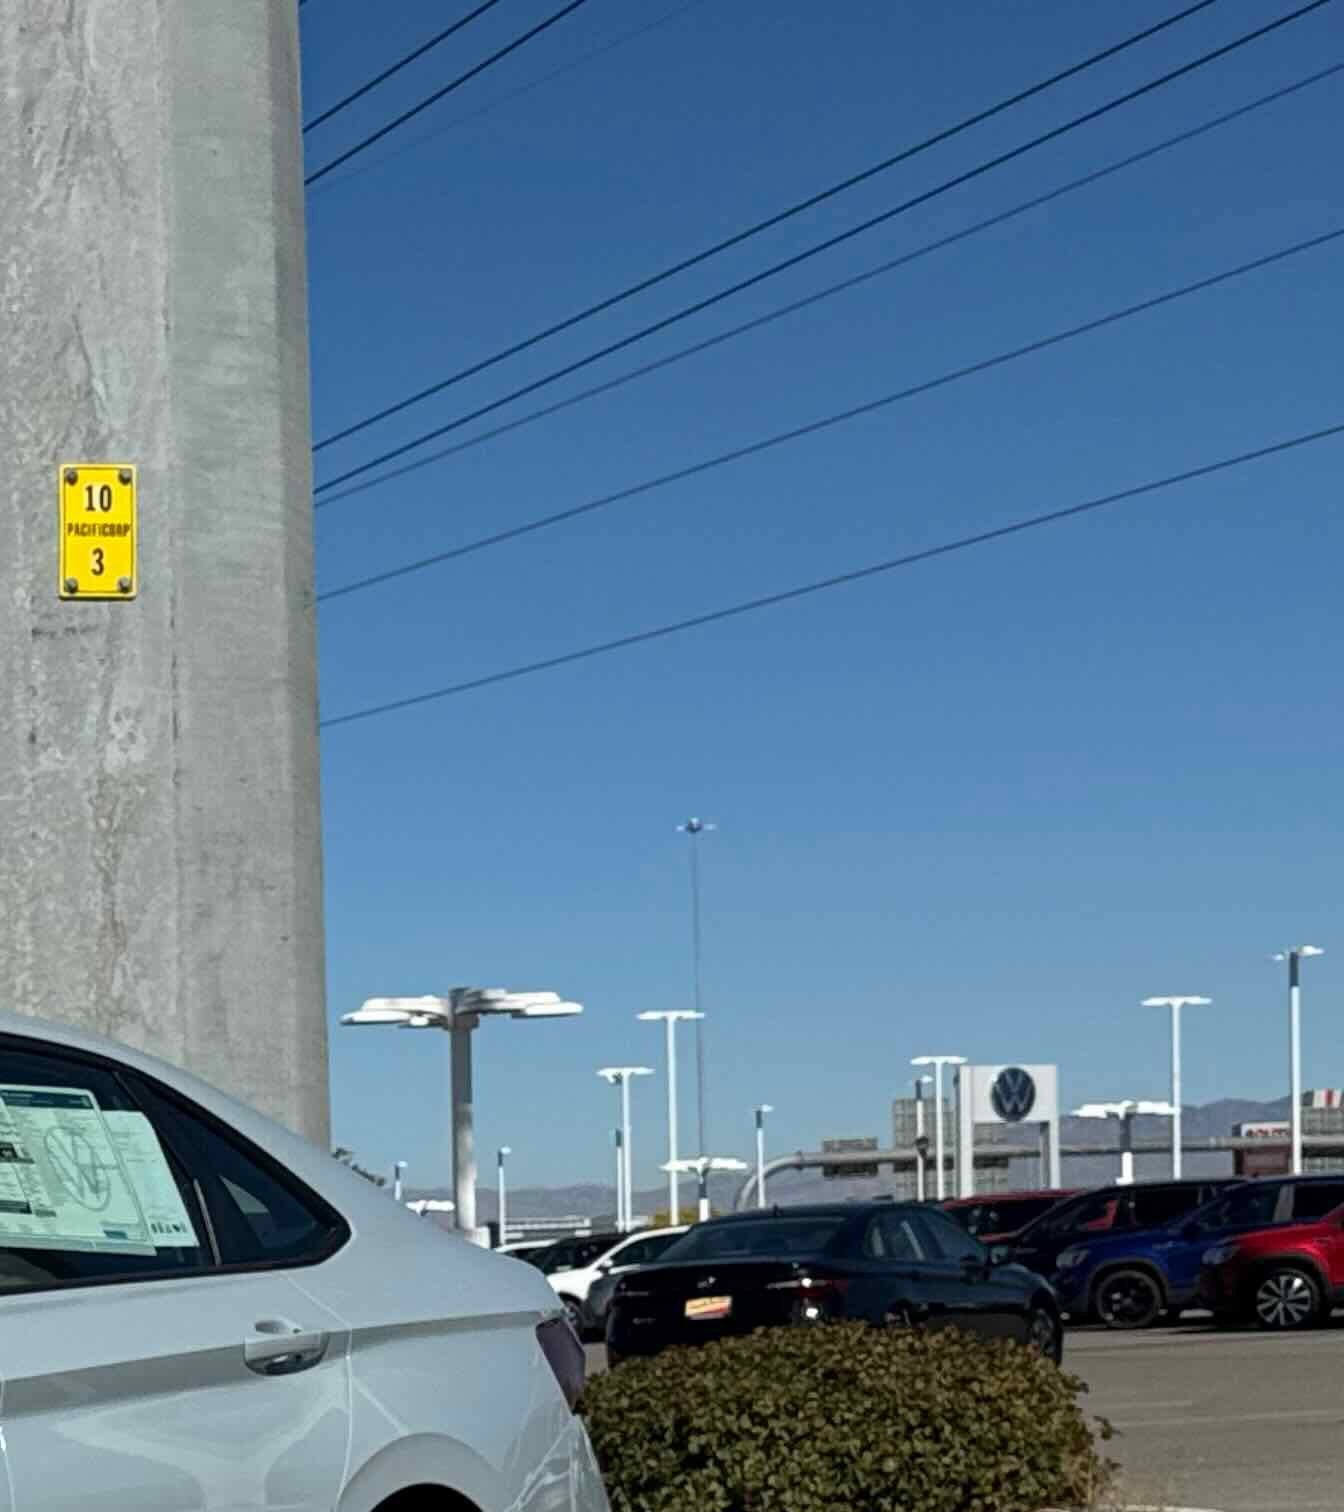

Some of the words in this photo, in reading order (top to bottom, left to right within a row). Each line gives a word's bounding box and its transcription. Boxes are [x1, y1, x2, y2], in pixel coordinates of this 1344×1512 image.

[85, 484, 113, 513] 10
[66, 522, 131, 537] PACIFICORP
[90, 546, 106, 577] 3
